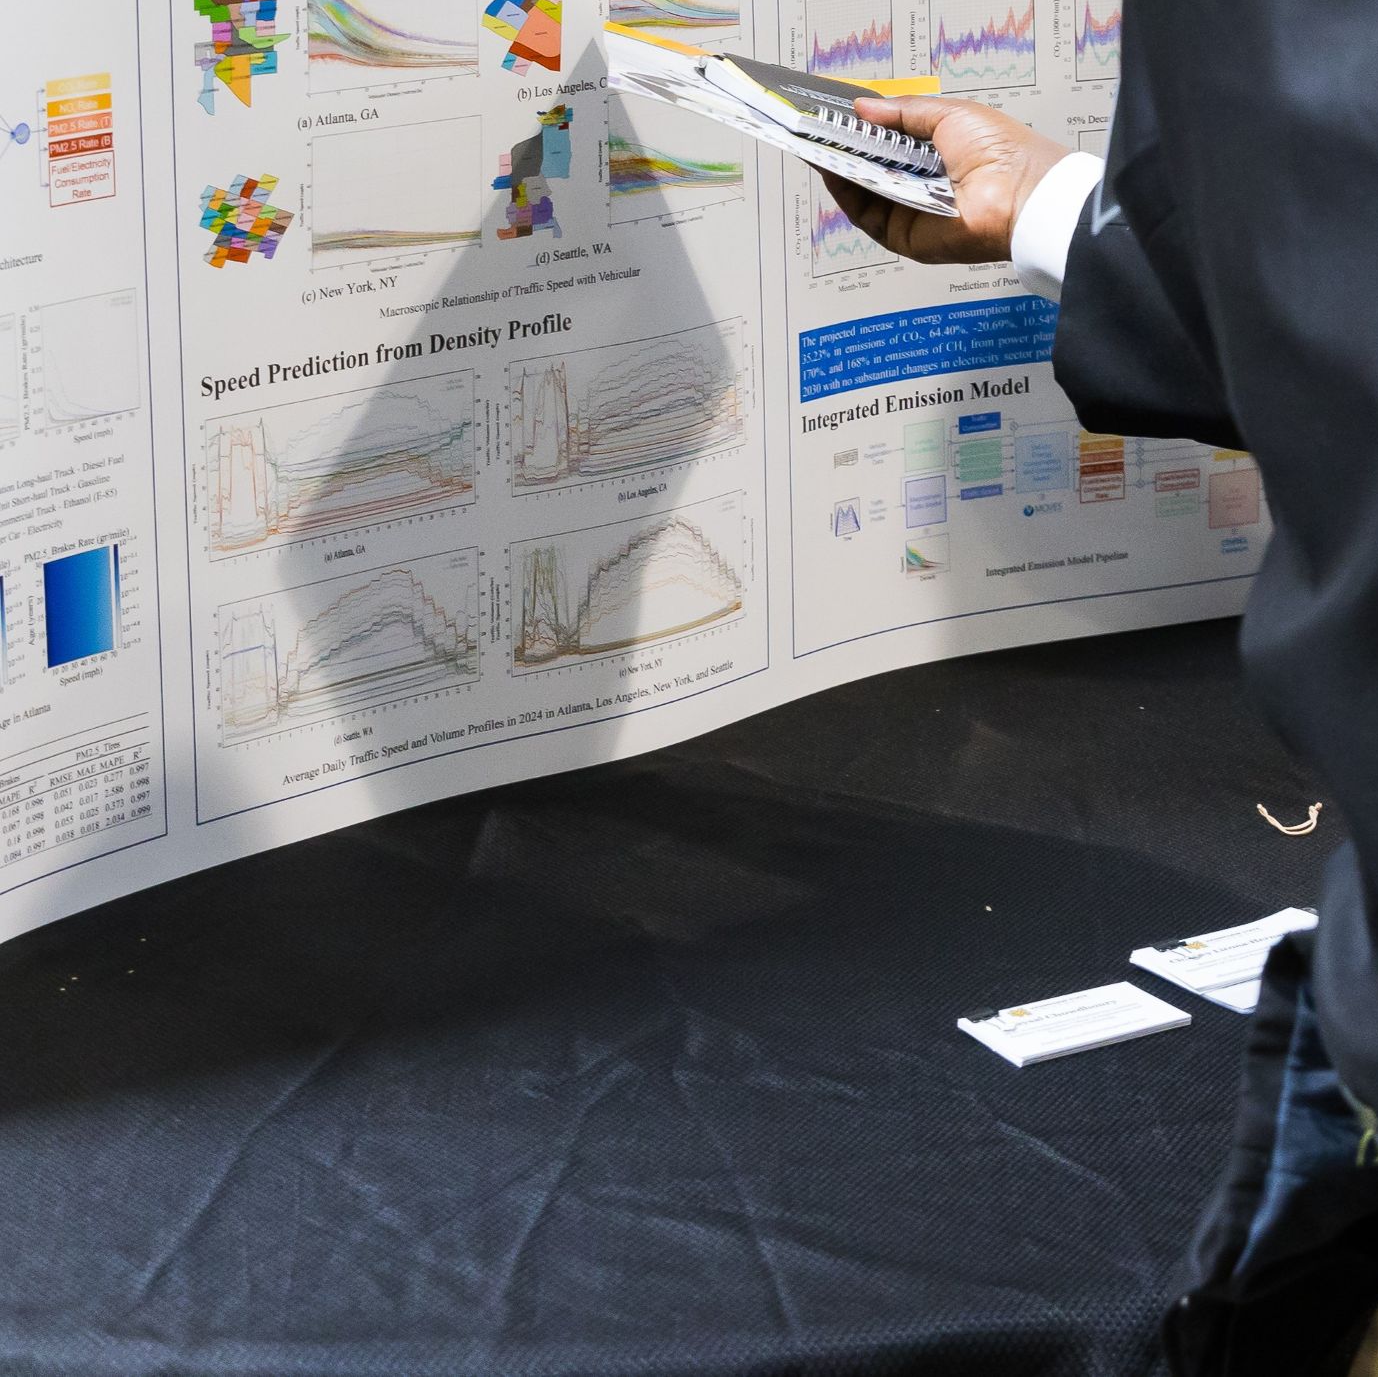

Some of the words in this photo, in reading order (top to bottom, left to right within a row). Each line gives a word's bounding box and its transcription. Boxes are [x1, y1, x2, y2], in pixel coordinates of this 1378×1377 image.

[517, 88, 532, 101] (b)
[534, 86, 552, 98] Los
[556, 80, 597, 96] Angeles,
[297, 117, 312, 131] (a)
[316, 113, 357, 127] Atlanta,
[361, 108, 379, 120] GA
[553, 246, 589, 262] Seattle,
[592, 243, 612, 254] WA
[302, 290, 316, 304] (c)
[319, 286, 343, 299] New
[347, 279, 376, 295] York,
[379, 276, 397, 288] NY
[379, 299, 439, 319] Macroscopic
[441, 290, 500, 309] Relationship
[502, 285, 511, 298] of
[514, 282, 544, 296] Traffic
[546, 276, 574, 293] Speed
[576, 273, 596, 286] with
[598, 267, 641, 283] Vehicular
[802, 333, 816, 348] The
[819, 328, 856, 346] projected
[859, 322, 893, 335] increase
[900, 318, 908, 327] in
[912, 313, 942, 327] energy
[948, 304, 1010, 320] consumption
[1016, 301, 1026, 312] of
[201, 367, 260, 400] Speed
[267, 352, 369, 384] Prediction
[375, 342, 422, 365] from
[429, 328, 502, 355] Density
[508, 312, 572, 340] Profile
[802, 399, 879, 434] Integrated
[886, 387, 964, 414] Emission
[970, 376, 1030, 398] Model
[282, 767, 319, 786] Average
[321, 758, 347, 776] Daily
[349, 749, 379, 766] Traffic
[381, 739, 409, 757] Speed
[410, 734, 428, 749] and
[430, 727, 465, 745] Volume
[468, 719, 504, 737] Profiles
[506, 714, 516, 727] in
[519, 709, 544, 725] 2024
[545, 705, 554, 718] in
[556, 698, 595, 714] Atlanta,
[596, 693, 612, 708] Los
[614, 687, 651, 705] Angeles,
[653, 680, 671, 695] New
[672, 676, 694, 690] York,
[695, 669, 709, 682] and
[710, 660, 734, 676] Seattle
